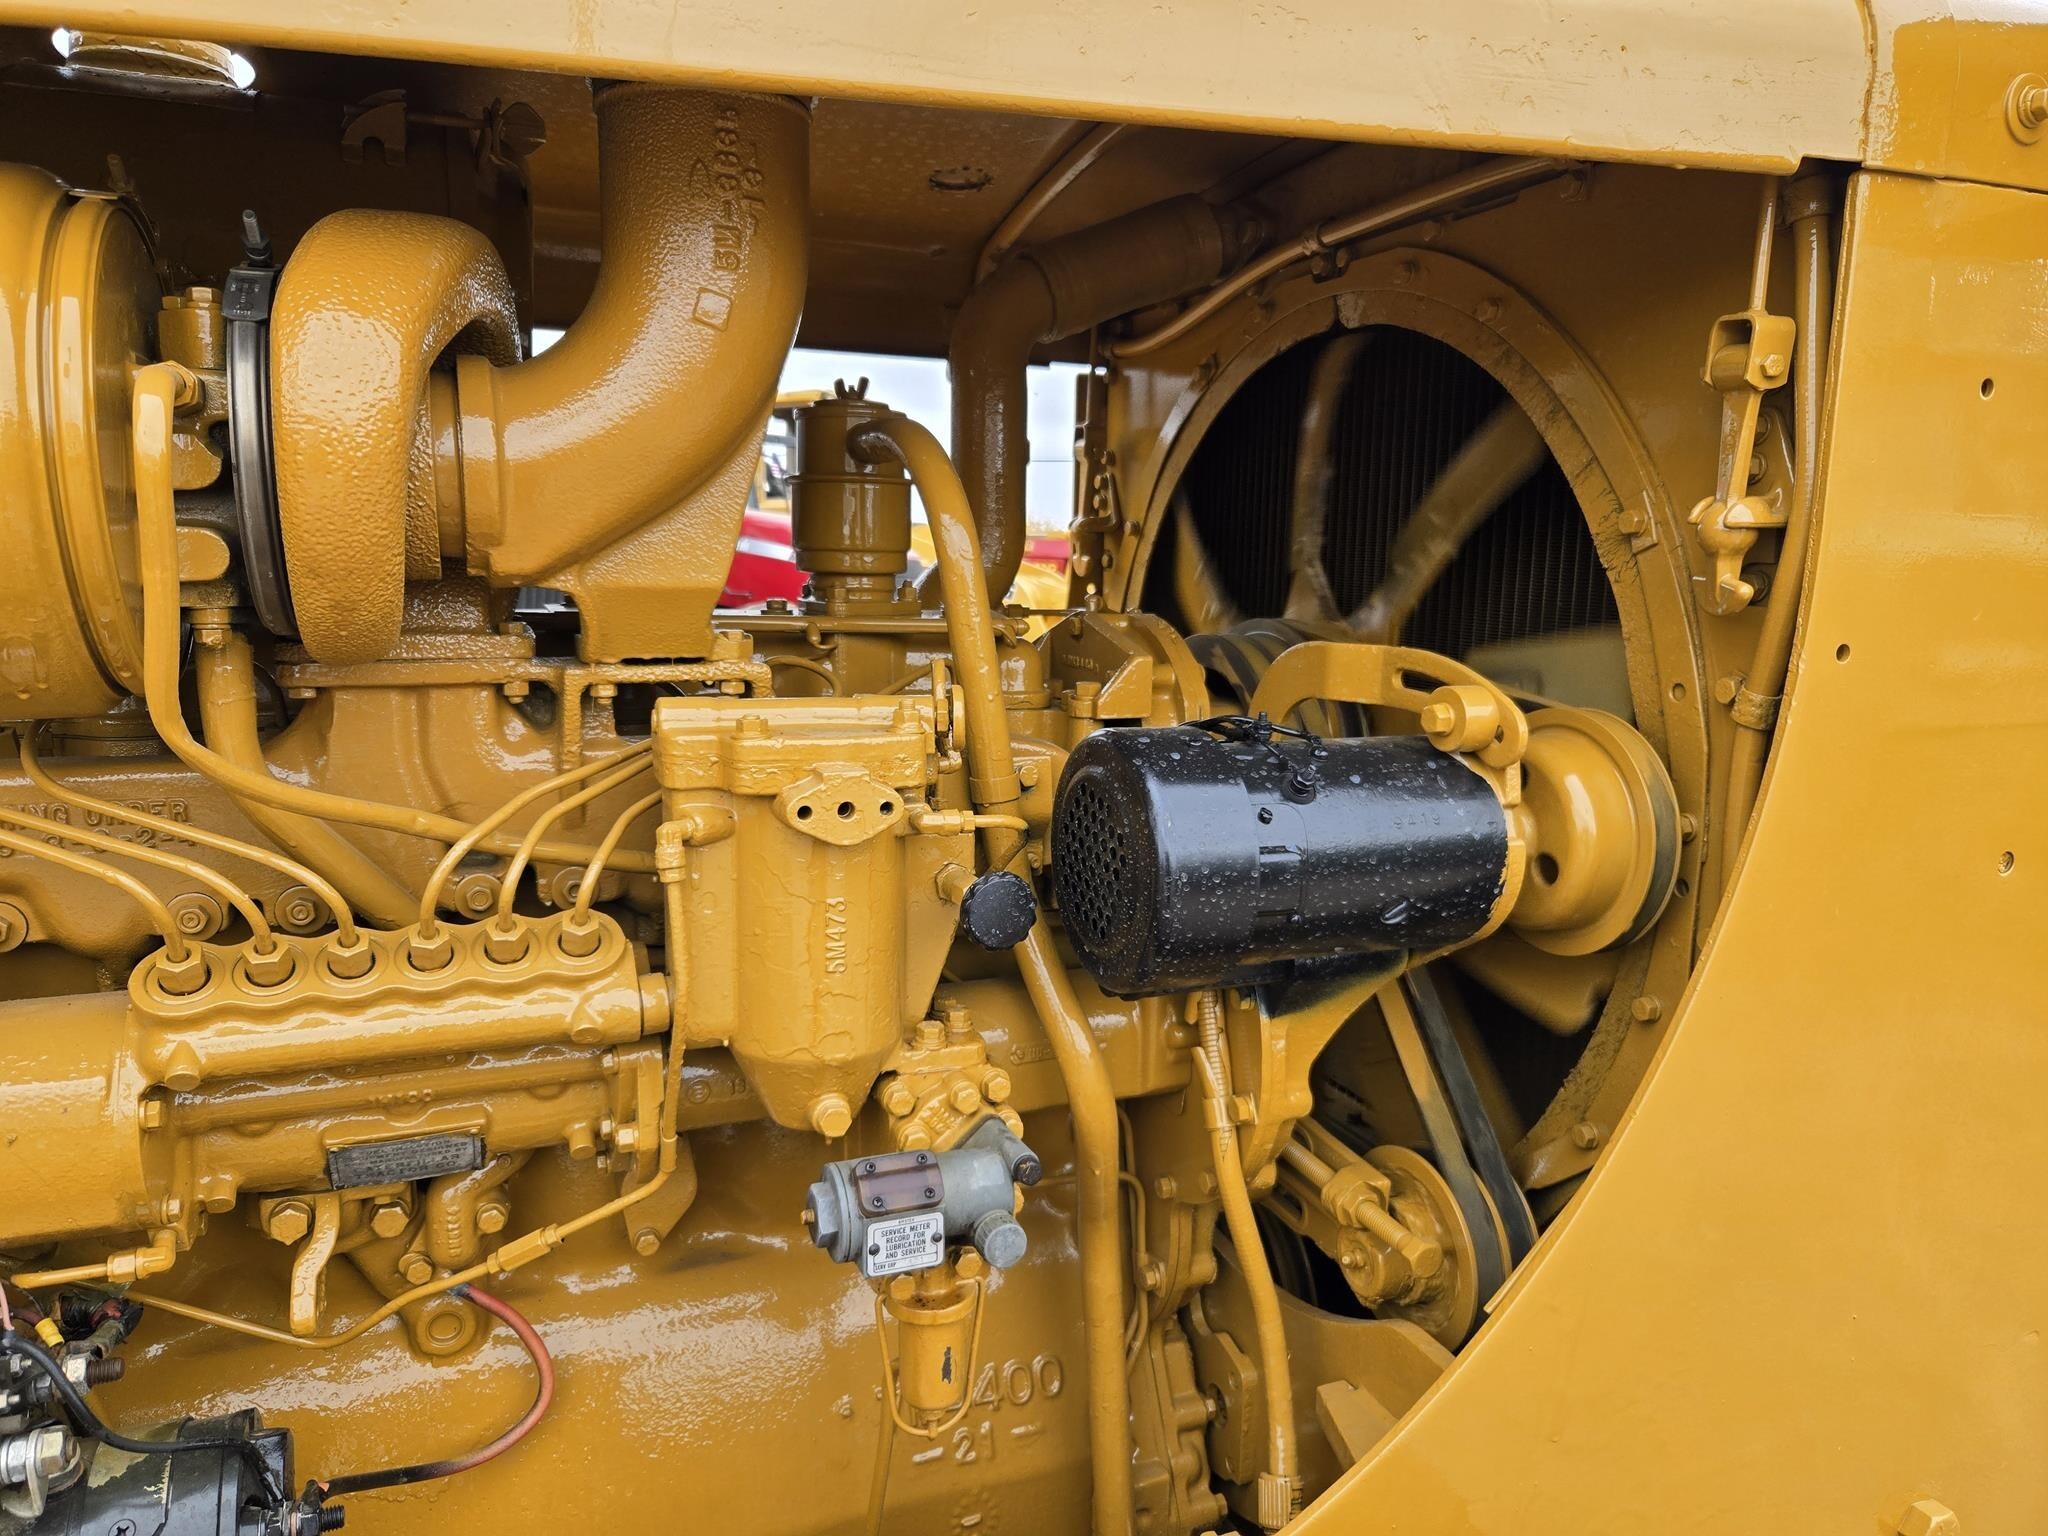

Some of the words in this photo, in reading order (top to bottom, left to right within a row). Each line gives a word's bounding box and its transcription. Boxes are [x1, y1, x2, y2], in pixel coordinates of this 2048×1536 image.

[825, 896, 848, 974] 5M473
[881, 1227, 906, 1238] SERVICE
[909, 1223, 931, 1232] METER
[886, 1233, 910, 1244] RECORD
[913, 1230, 925, 1238] FOR
[886, 1238, 926, 1251] LUBRICATION
[886, 1251, 898, 1259] AND
[901, 1246, 926, 1257] SERVICE
